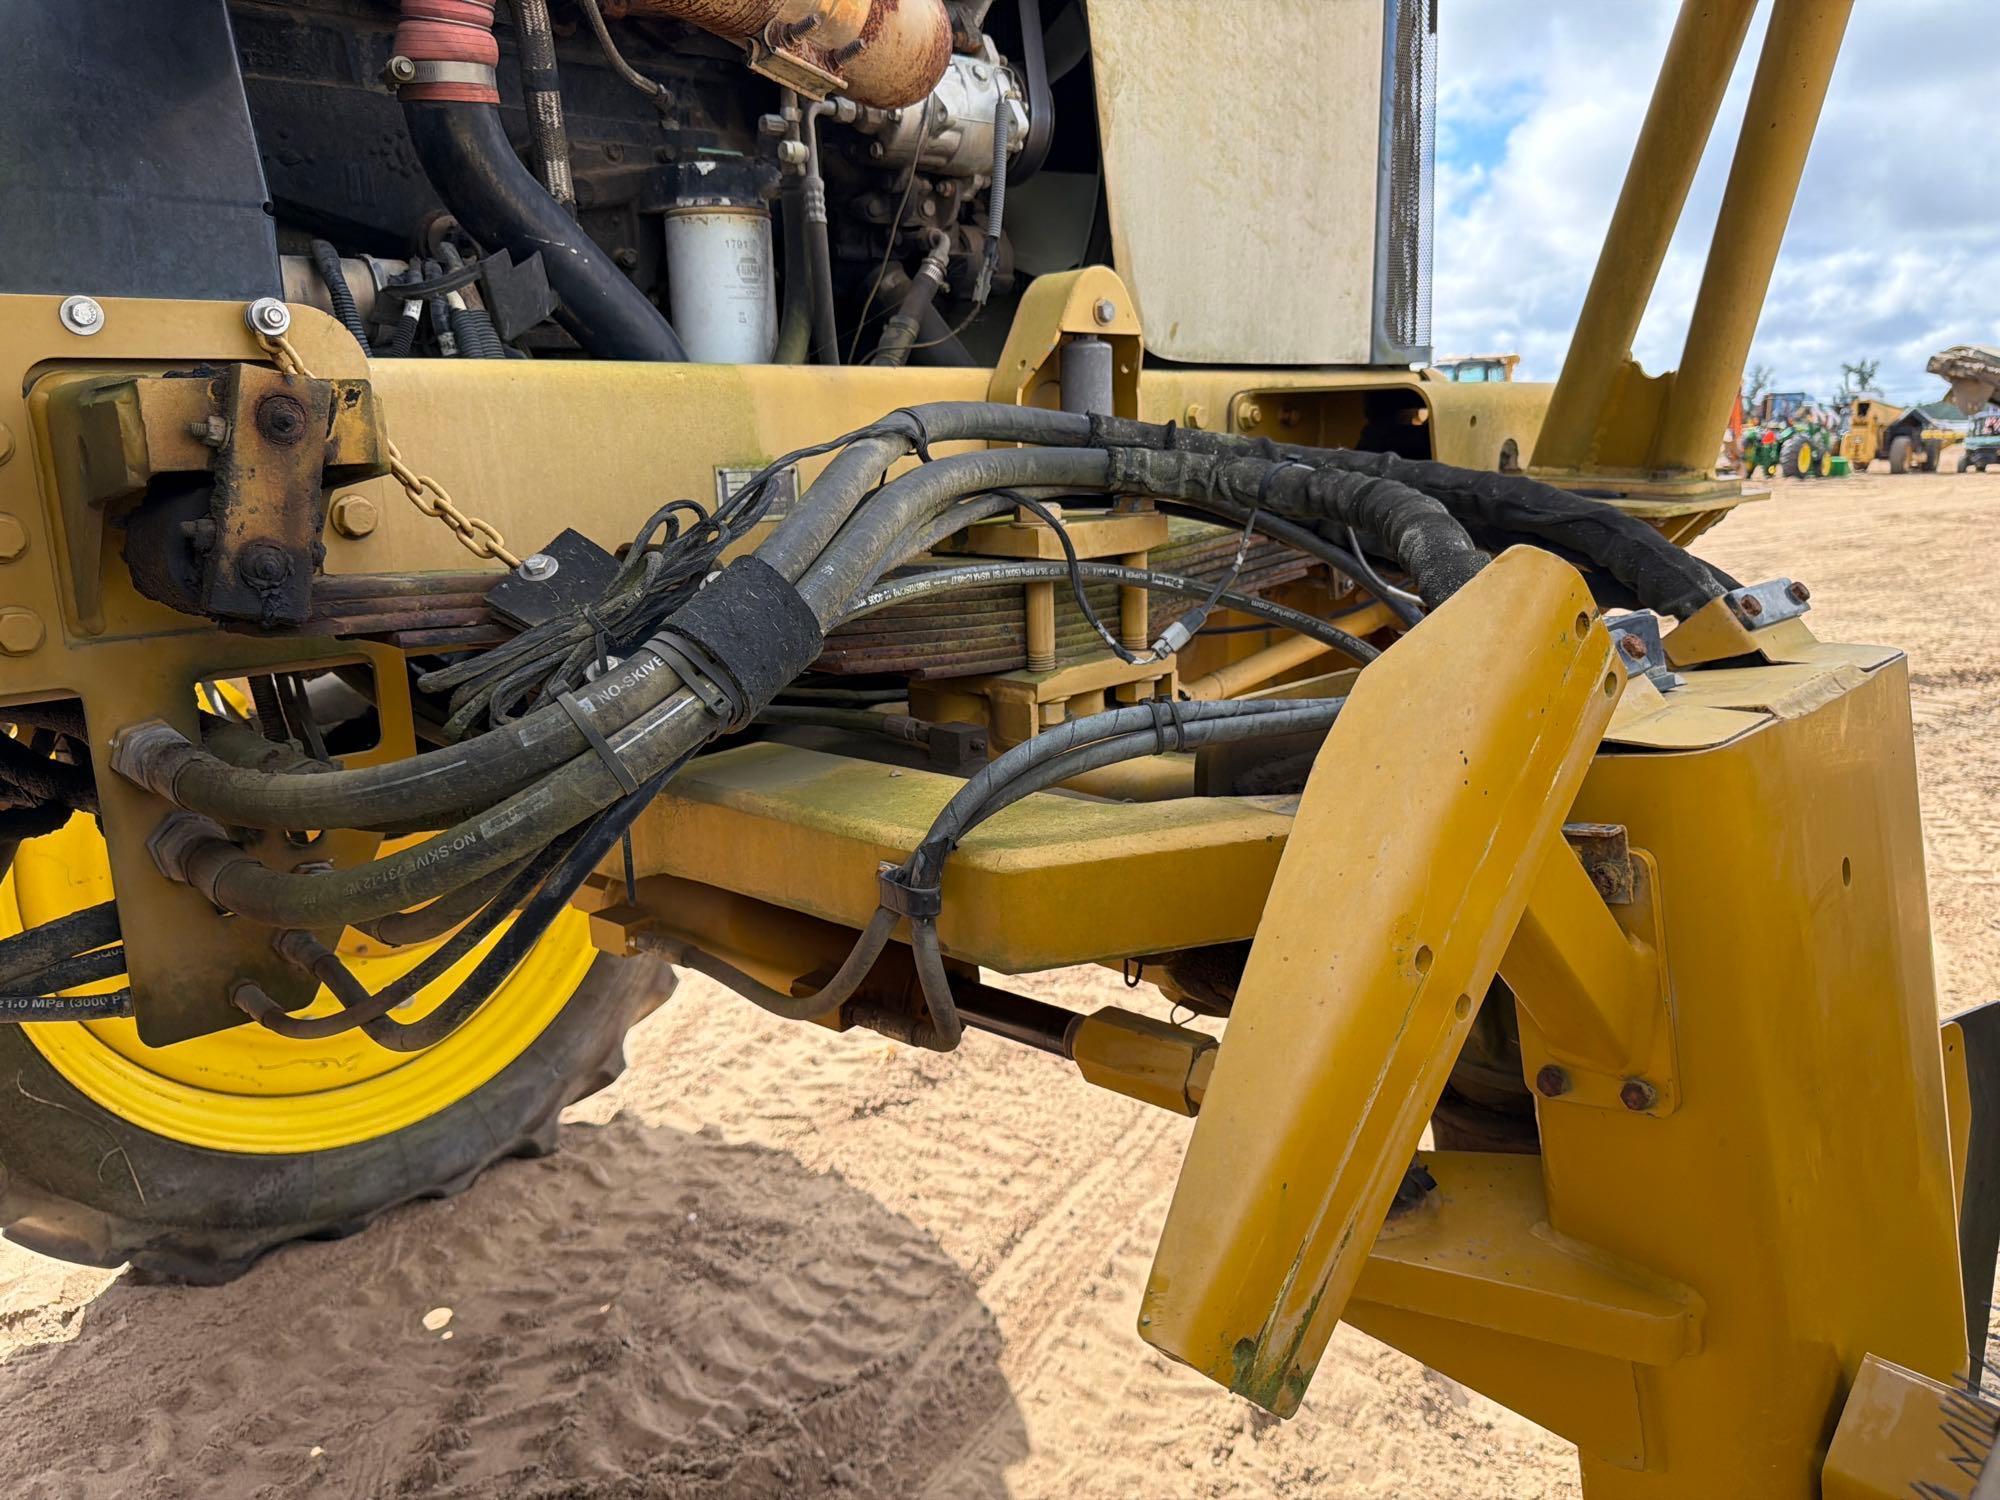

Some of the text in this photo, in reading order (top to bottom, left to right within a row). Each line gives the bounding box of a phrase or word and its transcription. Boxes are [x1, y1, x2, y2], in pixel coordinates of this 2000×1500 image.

[597, 655, 666, 705] NO-SKIVE
[408, 831, 477, 867] NO-SKIVE
[32, 997, 64, 1009] MPa
